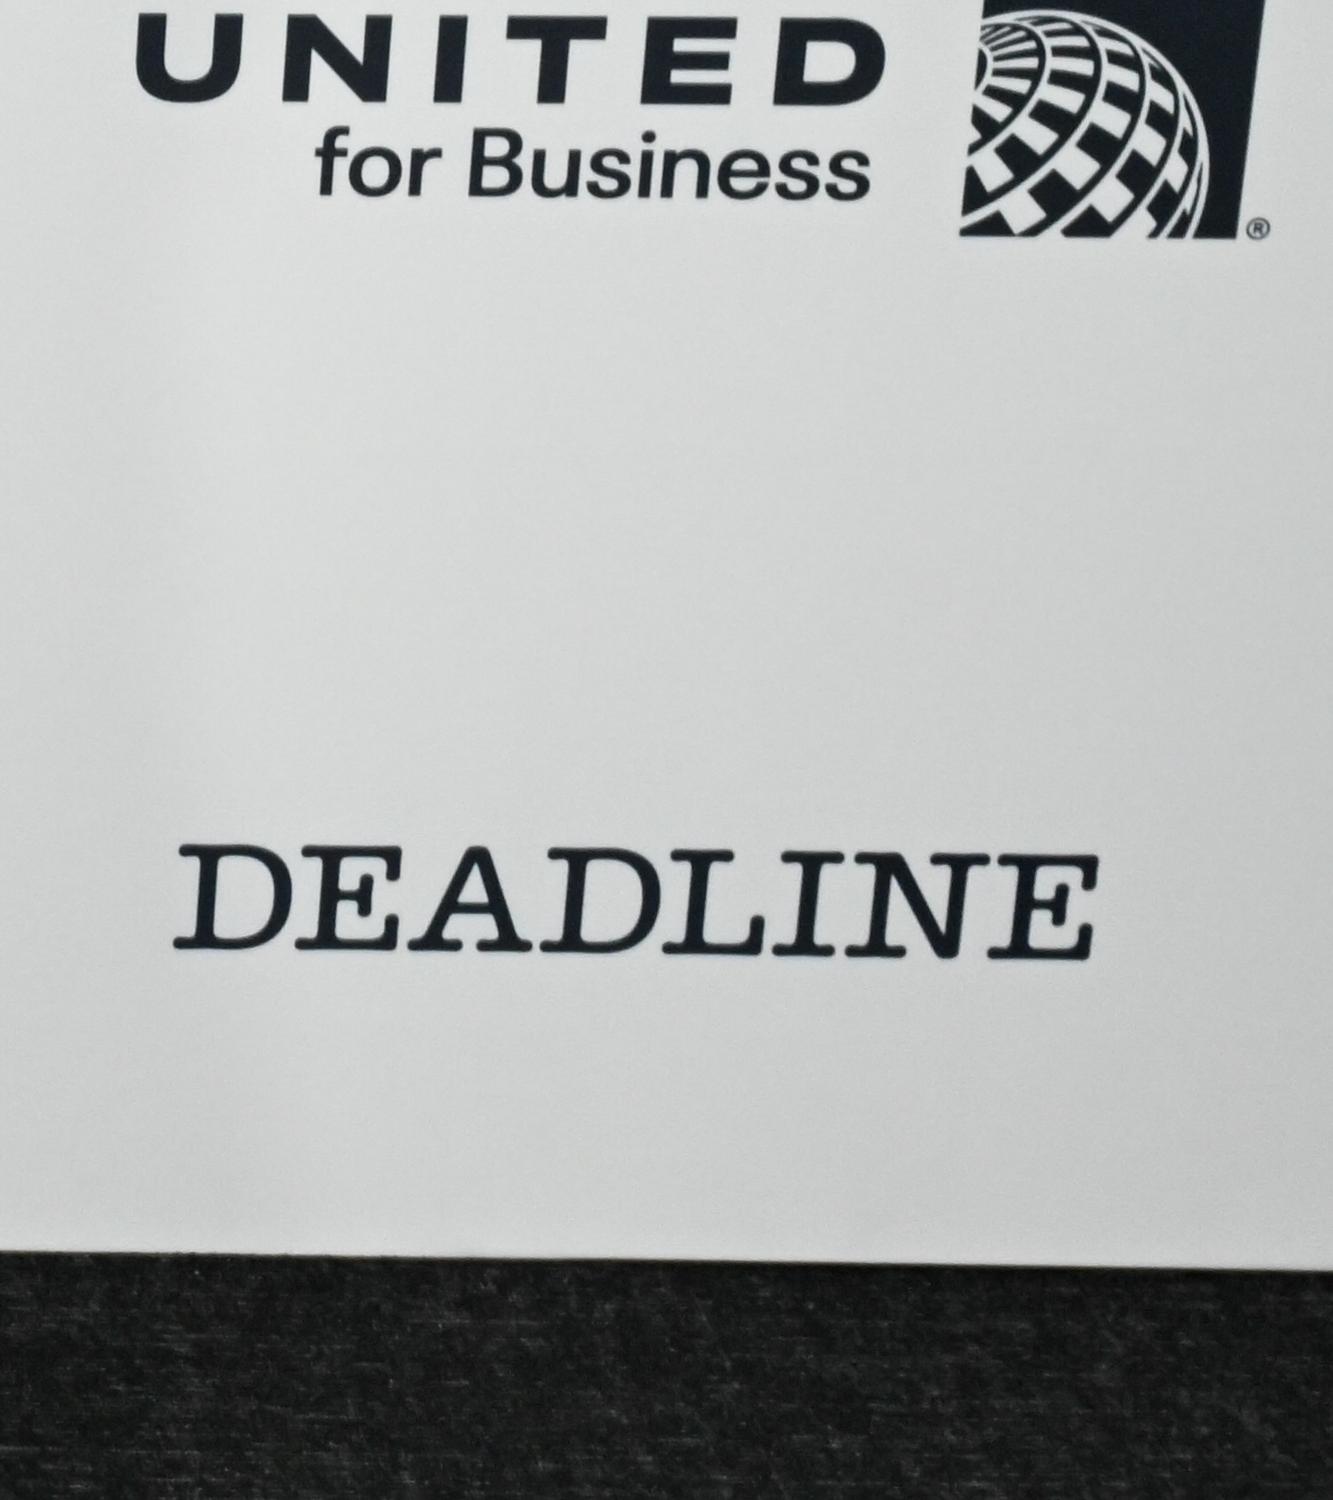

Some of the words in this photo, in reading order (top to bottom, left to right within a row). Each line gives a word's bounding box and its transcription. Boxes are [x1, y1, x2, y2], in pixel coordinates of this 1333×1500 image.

[134, 12, 887, 107] UNITED
[314, 126, 444, 199] for
[468, 127, 872, 203] Business
[171, 843, 1101, 963] DEADLINE
